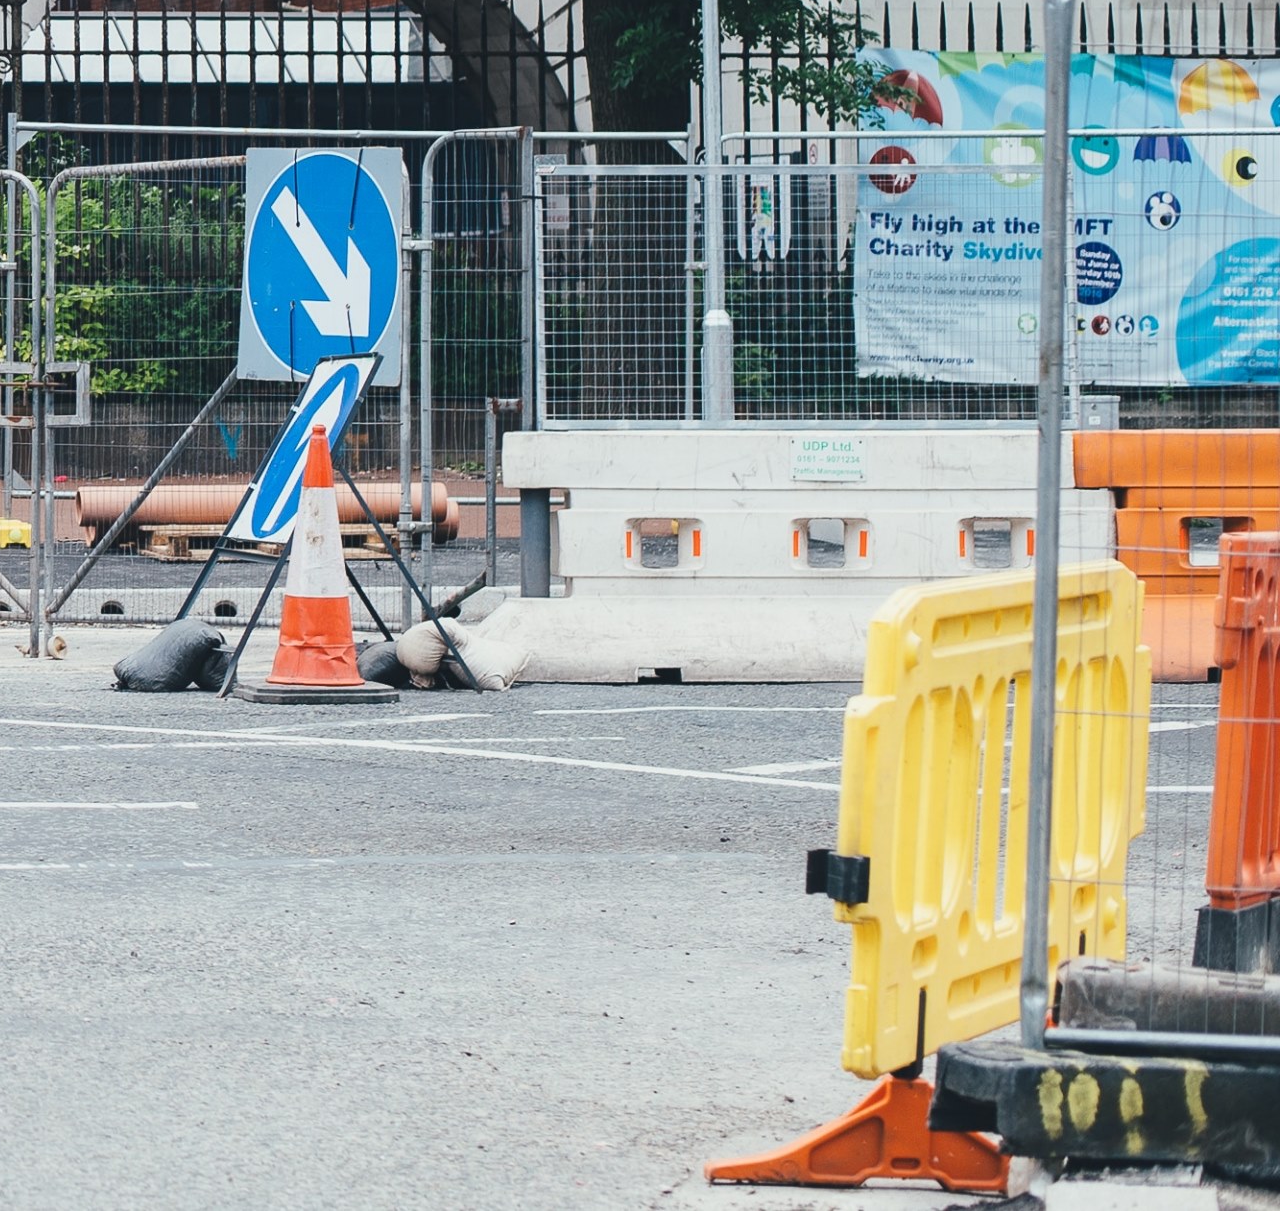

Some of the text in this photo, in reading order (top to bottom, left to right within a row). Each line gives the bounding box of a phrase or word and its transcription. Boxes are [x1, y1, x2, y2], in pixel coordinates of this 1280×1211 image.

[869, 212, 903, 234] Fly
[912, 214, 964, 235] high
[972, 217, 996, 235] at
[1004, 217, 1041, 235] the
[869, 237, 954, 262] Charity
[1080, 249, 1111, 261] Sunday
[803, 441, 854, 452] UDP Ltd.
[797, 455, 816, 463] 0161
[793, 467, 862, 476] Traffic Management
